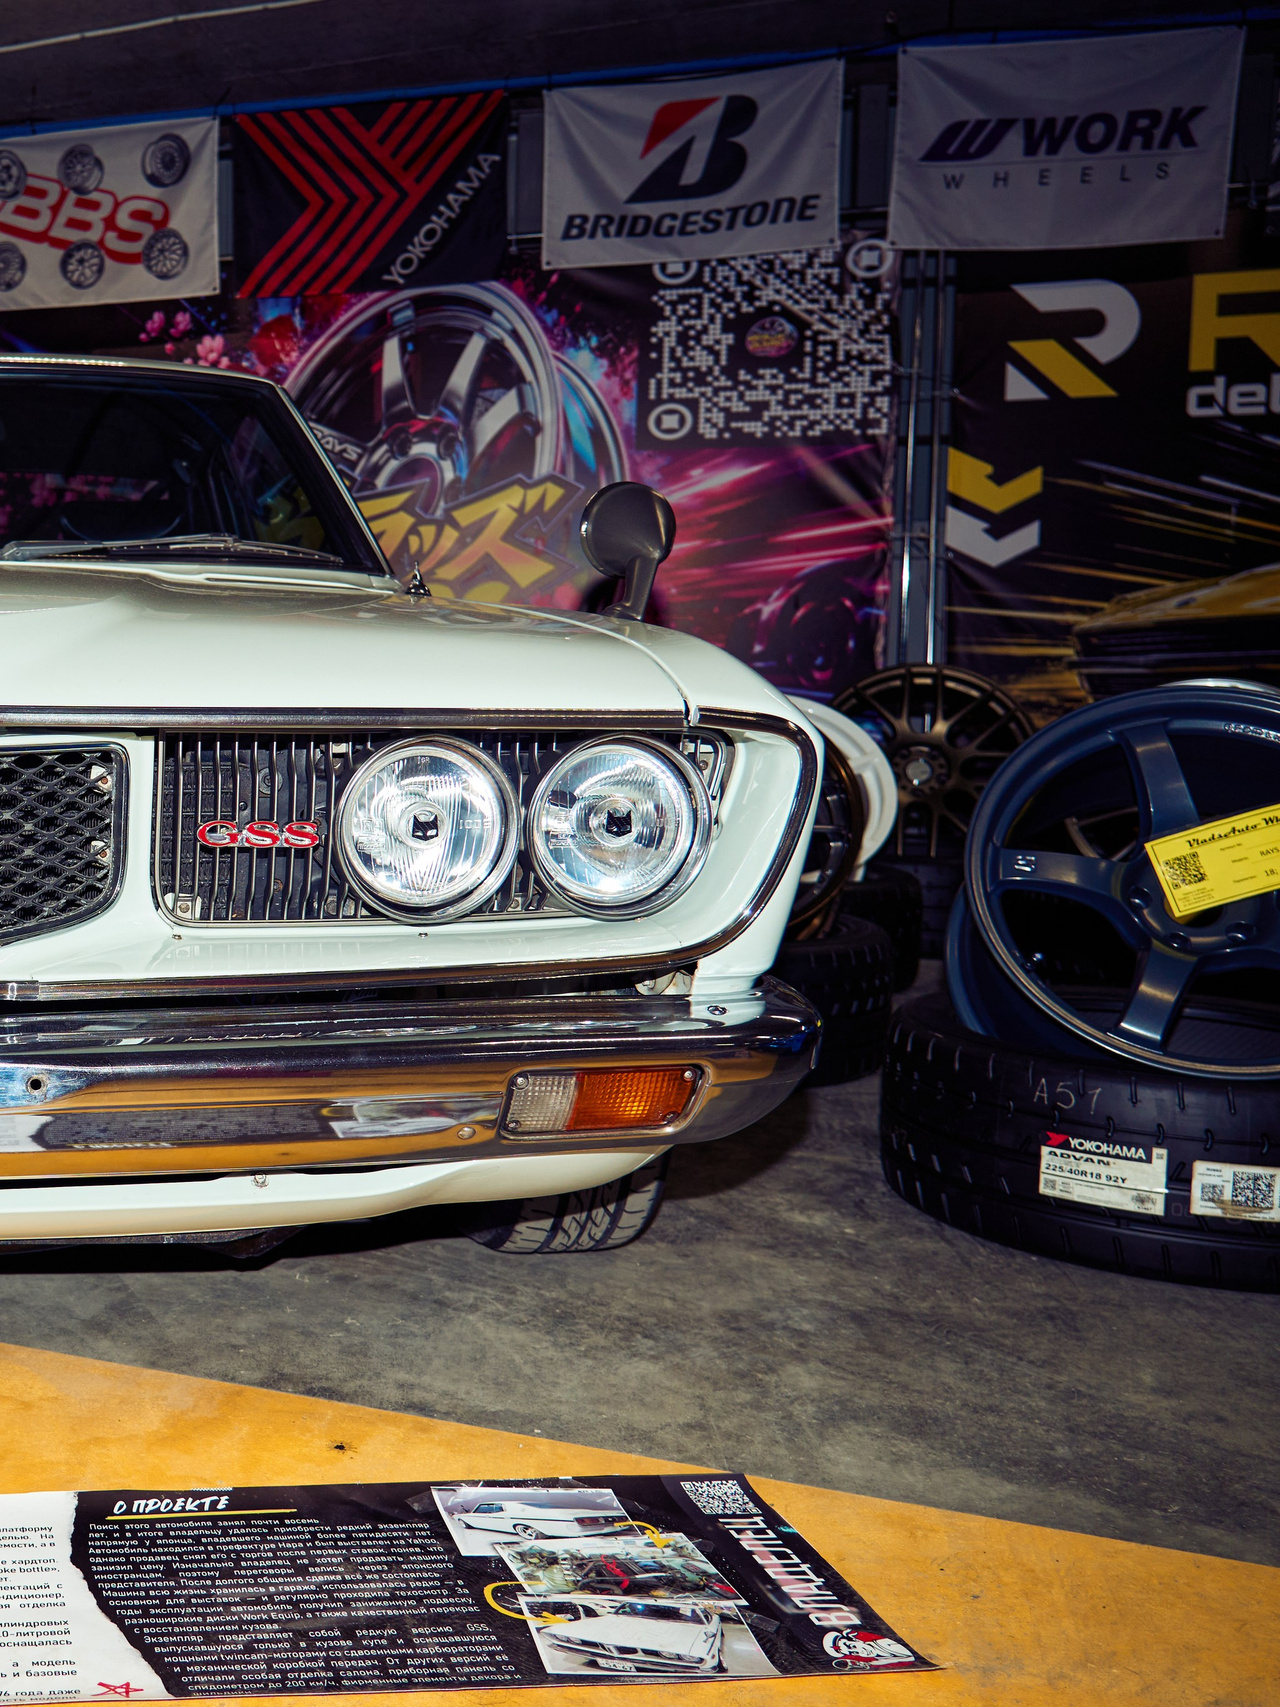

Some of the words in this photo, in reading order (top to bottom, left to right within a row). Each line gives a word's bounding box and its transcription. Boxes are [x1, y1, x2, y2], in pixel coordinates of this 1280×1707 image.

[1021, 106, 1209, 158] WORK
[381, 151, 502, 287] YOKOHAMA
[559, 193, 821, 242] BRIDGESTONE
[196, 820, 320, 849] GSS
[1048, 1150, 1112, 1166] ADVAN
[1068, 1136, 1146, 1160] YOKOHAMA
[1105, 1174, 1128, 1184] 92Y
[131, 1495, 230, 1514] ПРОЕКТЕ
[718, 1516, 863, 1626] ВЛАДЕЛЕЦ
[18, 1601, 66, 1609] отделка
[24, 1669, 77, 1677] базовые
[30, 1659, 76, 1667] модель
